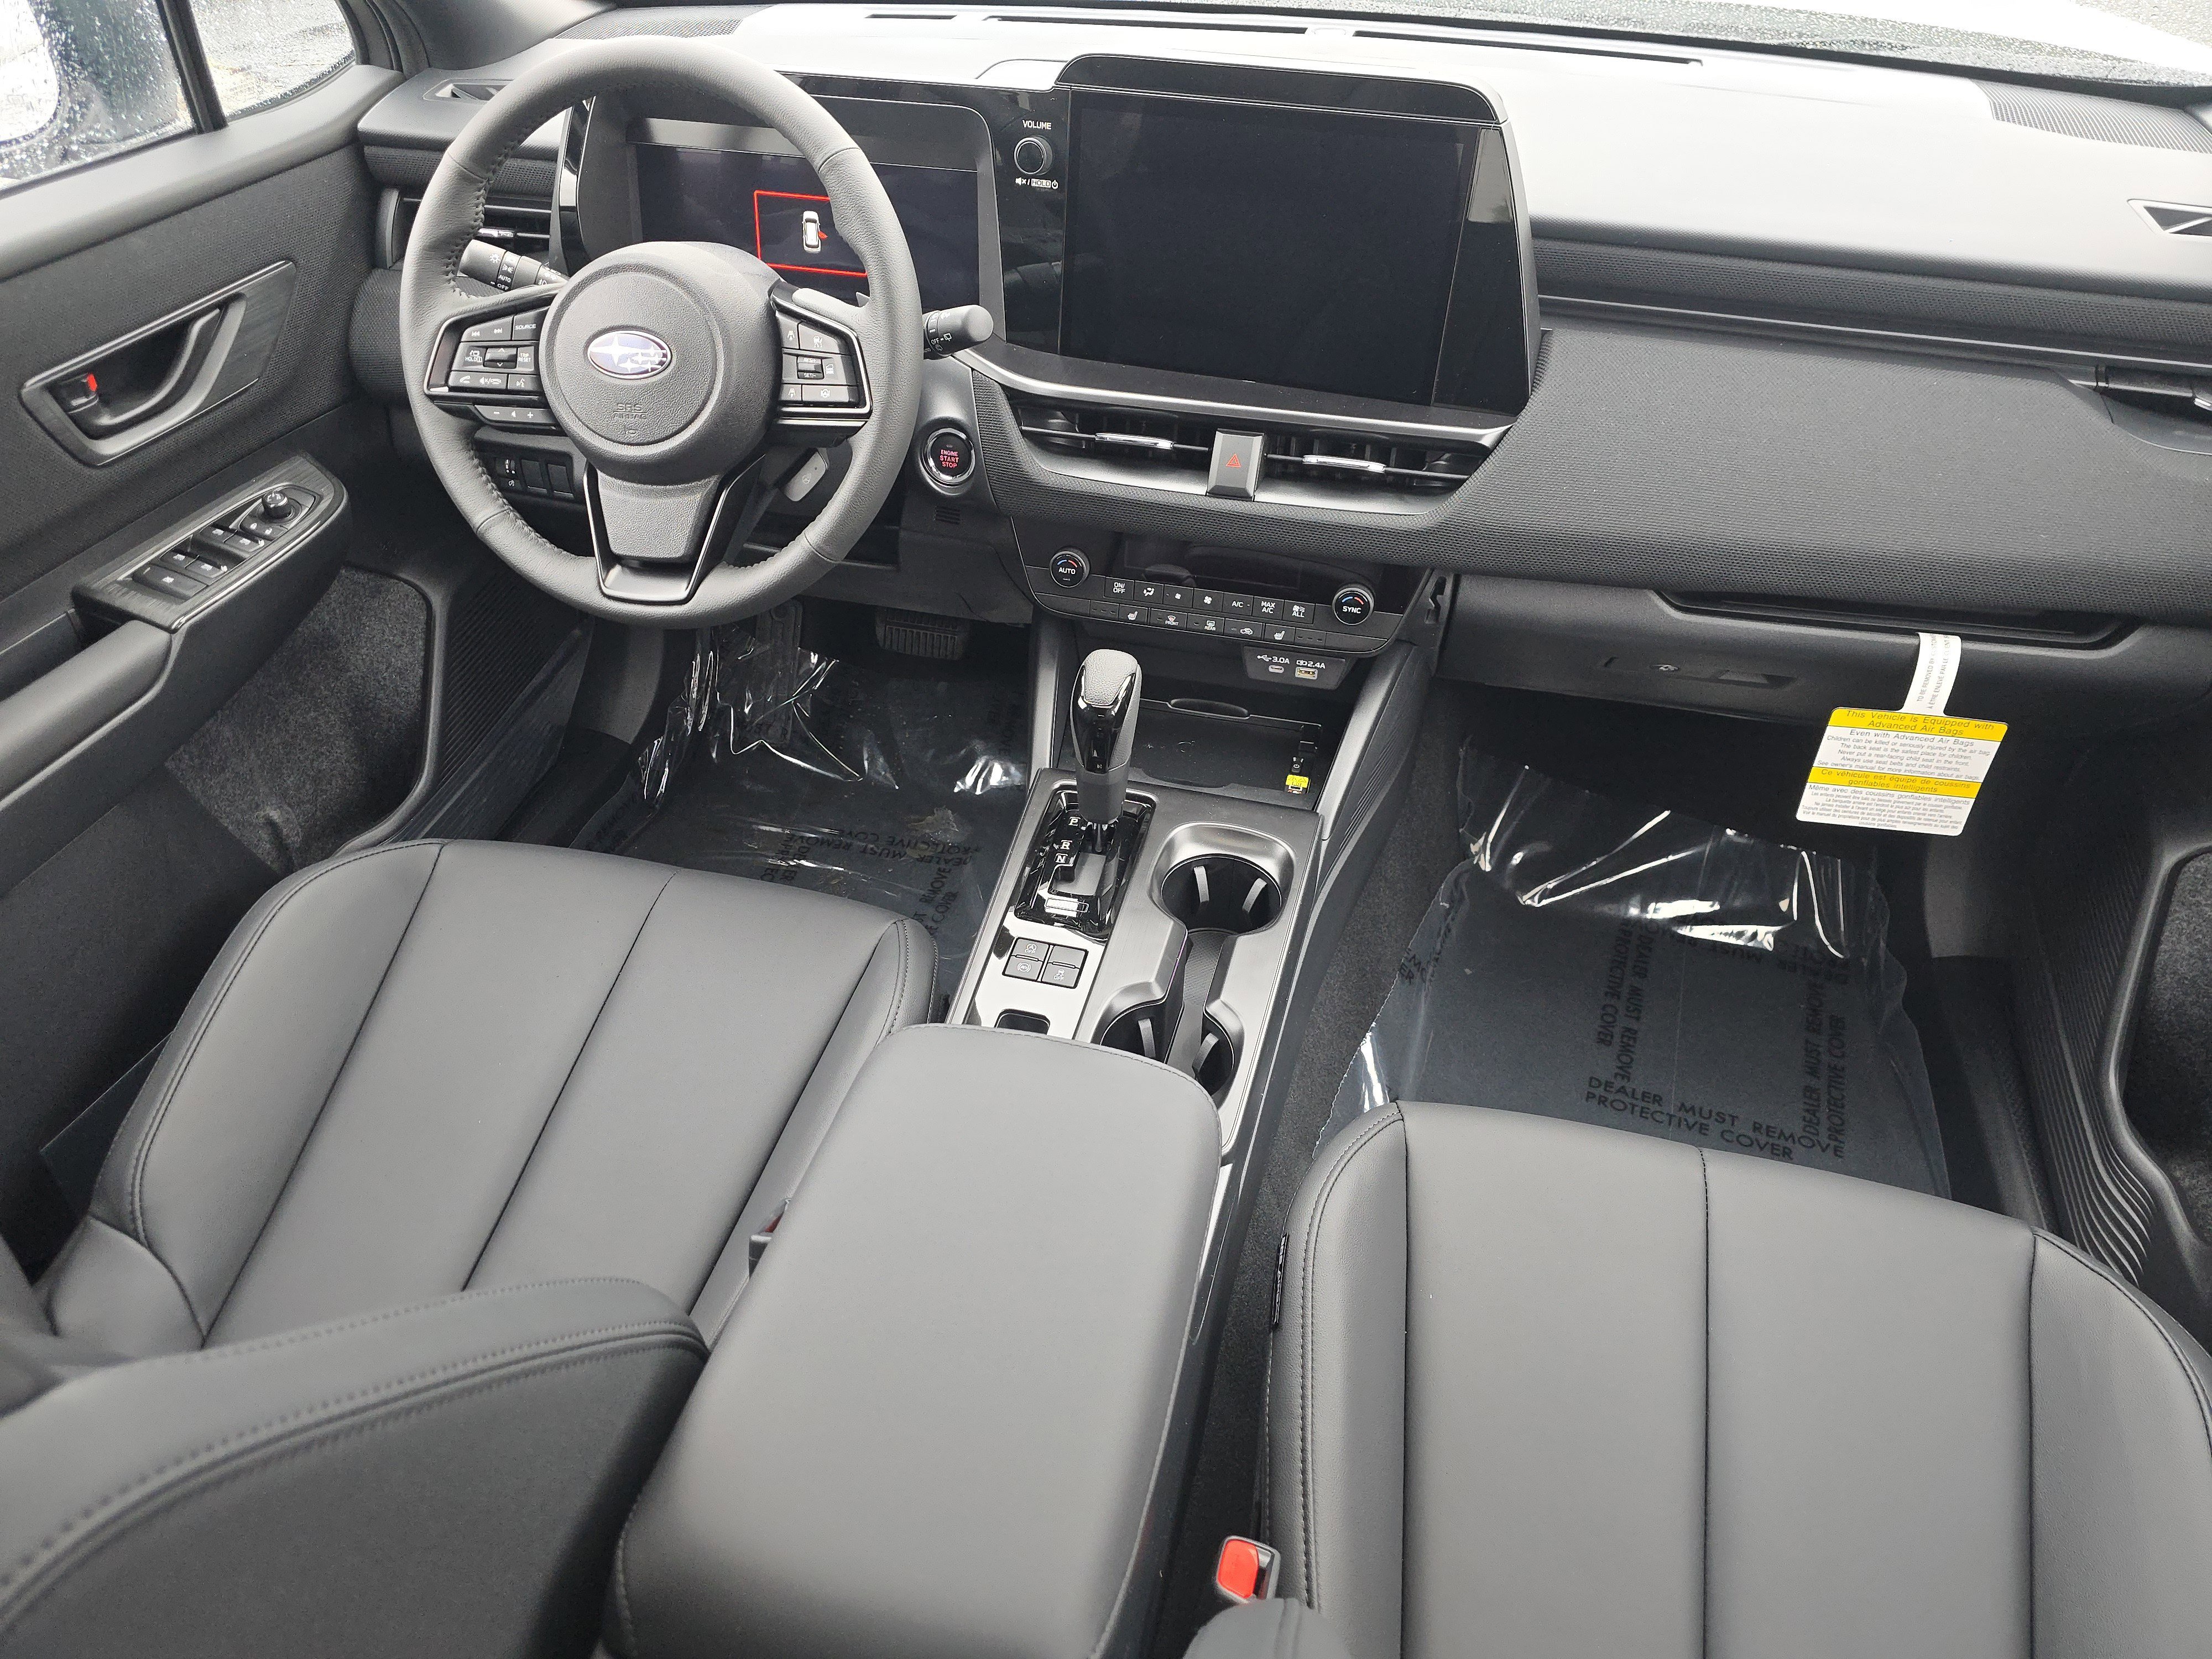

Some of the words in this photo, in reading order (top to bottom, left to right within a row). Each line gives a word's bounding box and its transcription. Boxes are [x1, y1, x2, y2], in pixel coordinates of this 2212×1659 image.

[1022, 119, 1052, 130] VOLUME
[498, 274, 511, 283] AUTO
[940, 455, 959, 463] START
[1342, 606, 1361, 614] SYNC
[1272, 656, 1290, 664] 3.0A
[1307, 661, 1326, 669] 2.4A
[1870, 712, 1906, 721] Vehicle
[1922, 717, 1970, 728] Equipped
[1868, 720, 1917, 730] Advanced
[1938, 727, 1964, 737] Bags
[1893, 733, 1935, 742] Advanced
[1953, 739, 1974, 748] Bags
[1847, 779, 1890, 789] gonflables
[1893, 783, 1938, 794] intelligents
[1068, 818, 1079, 827] P
[1060, 841, 1071, 850] R
[859, 846, 907, 859] MUST
[1055, 855, 1066, 863] N
[1596, 1004, 1619, 1047] COVER
[1614, 1026, 1639, 1083] REMOVE
[1588, 1076, 1663, 1107] DEALER
[1678, 1101, 1739, 1127] MUST
[1752, 1121, 1844, 1159] REMOVE
[1585, 1091, 1710, 1136] PROTECTIVE
[1720, 1128, 1794, 1160] COVER
